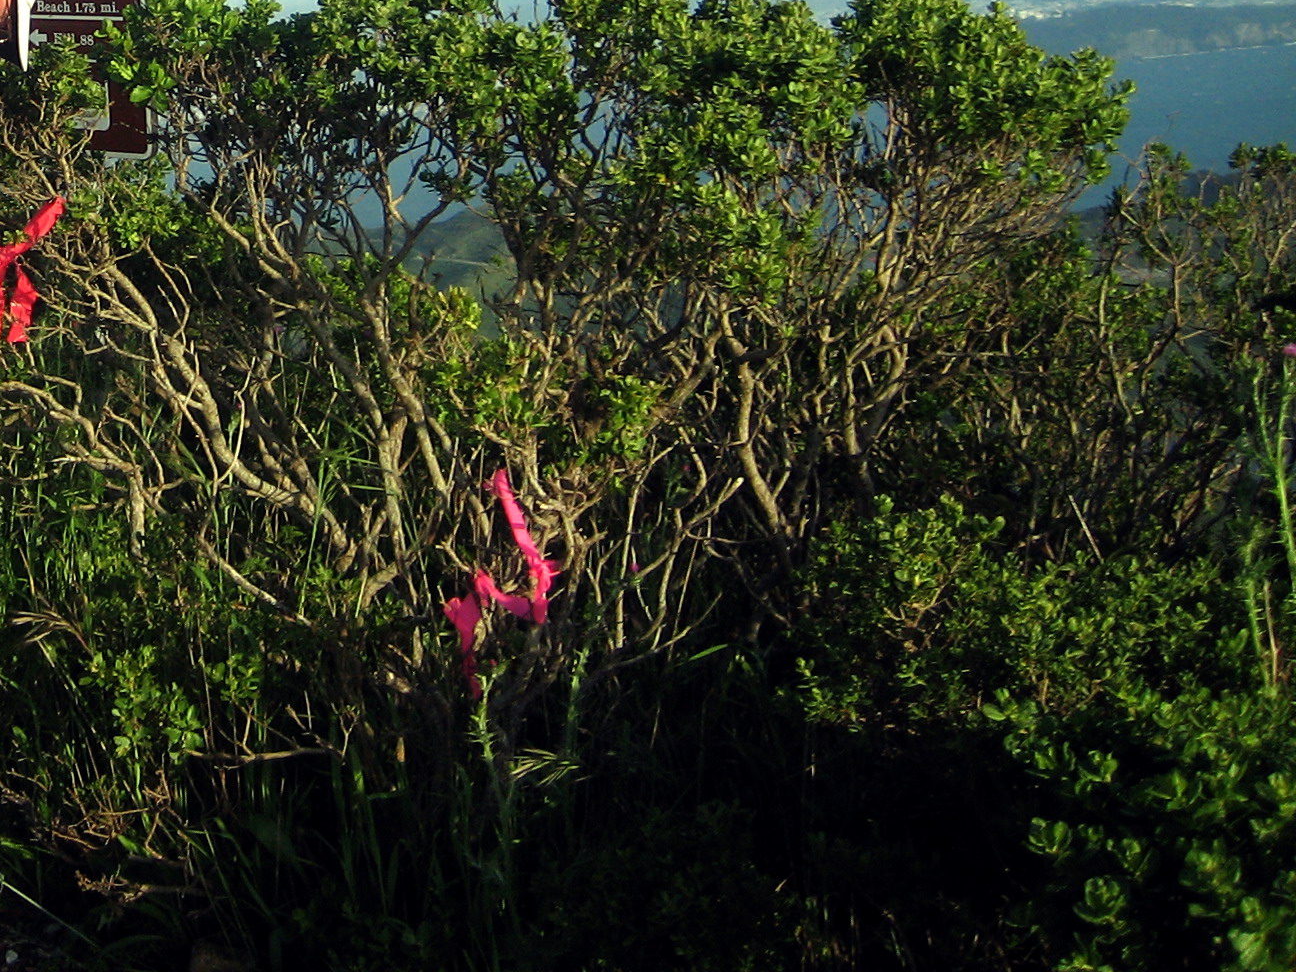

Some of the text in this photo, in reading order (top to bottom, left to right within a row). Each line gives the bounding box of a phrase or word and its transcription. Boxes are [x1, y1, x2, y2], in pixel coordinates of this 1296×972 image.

[36, 0, 120, 14] Beach 1.75 mi.
[80, 34, 94, 46] 88
